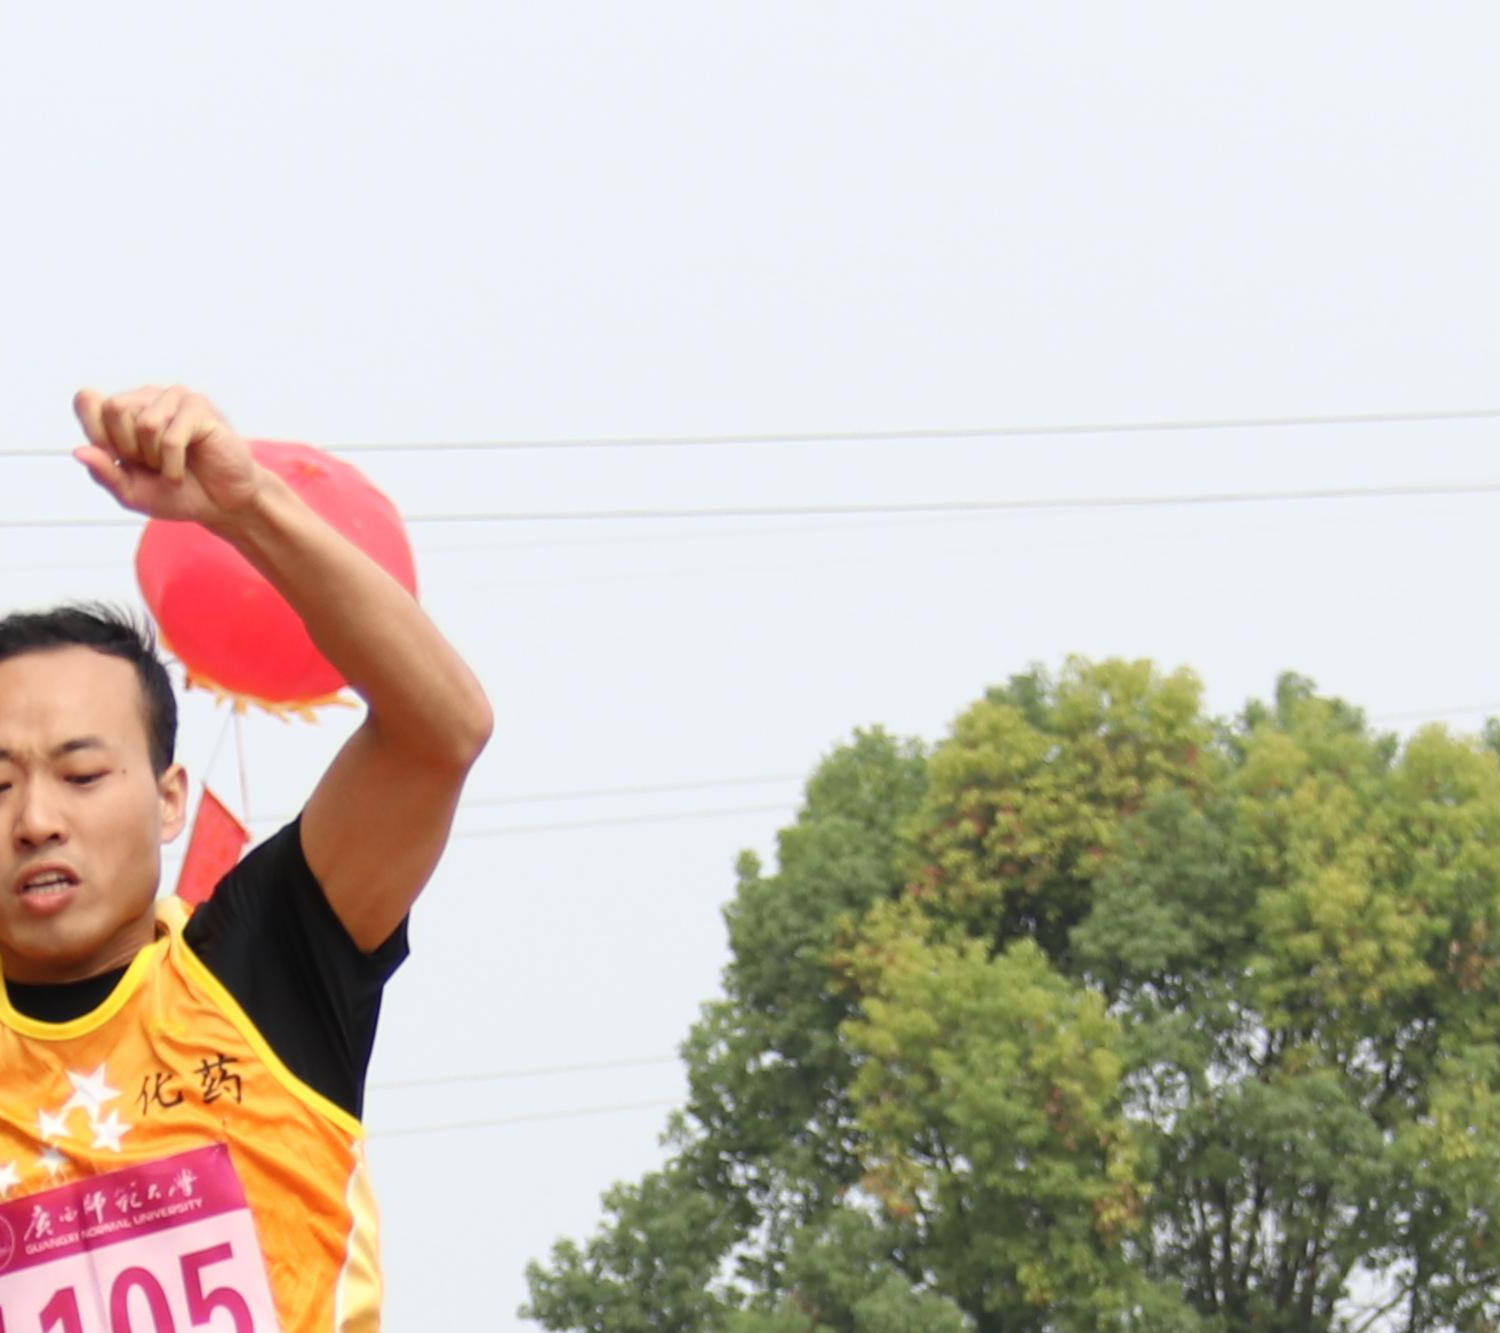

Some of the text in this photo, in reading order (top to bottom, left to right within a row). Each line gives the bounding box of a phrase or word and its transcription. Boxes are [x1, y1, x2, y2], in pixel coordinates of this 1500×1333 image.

[137, 1052, 244, 1117] 化药
[80, 1218, 132, 1240] NORMAL
[132, 1197, 204, 1227] UNIVERSITY
